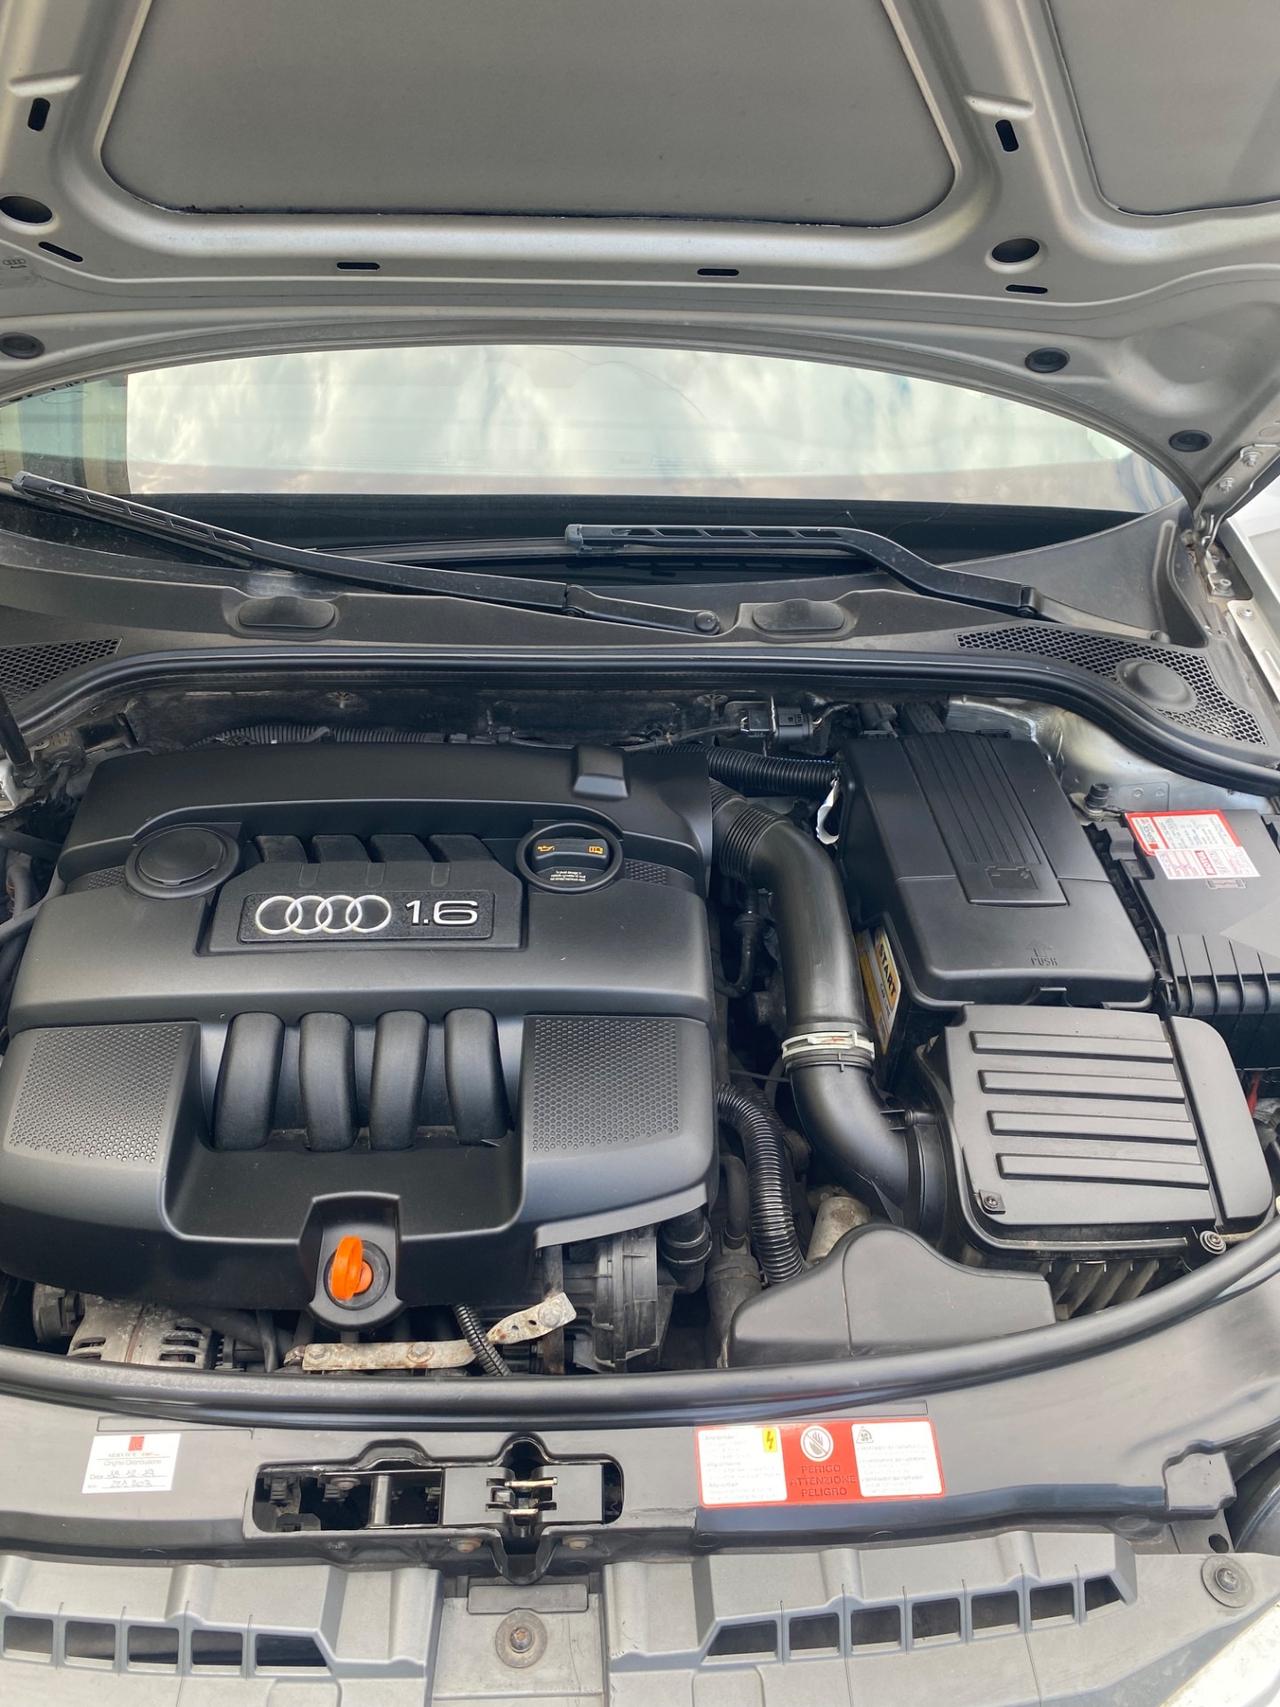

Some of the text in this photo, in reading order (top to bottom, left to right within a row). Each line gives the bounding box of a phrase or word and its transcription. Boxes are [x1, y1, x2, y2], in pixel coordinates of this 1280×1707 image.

[405, 899, 478, 926] 1.6
[1030, 957, 1058, 967] PUSH
[800, 1464, 841, 1474] PERIGO
[789, 1475, 856, 1486] ATTENZIONE
[800, 1487, 848, 1497] PELIGRO
